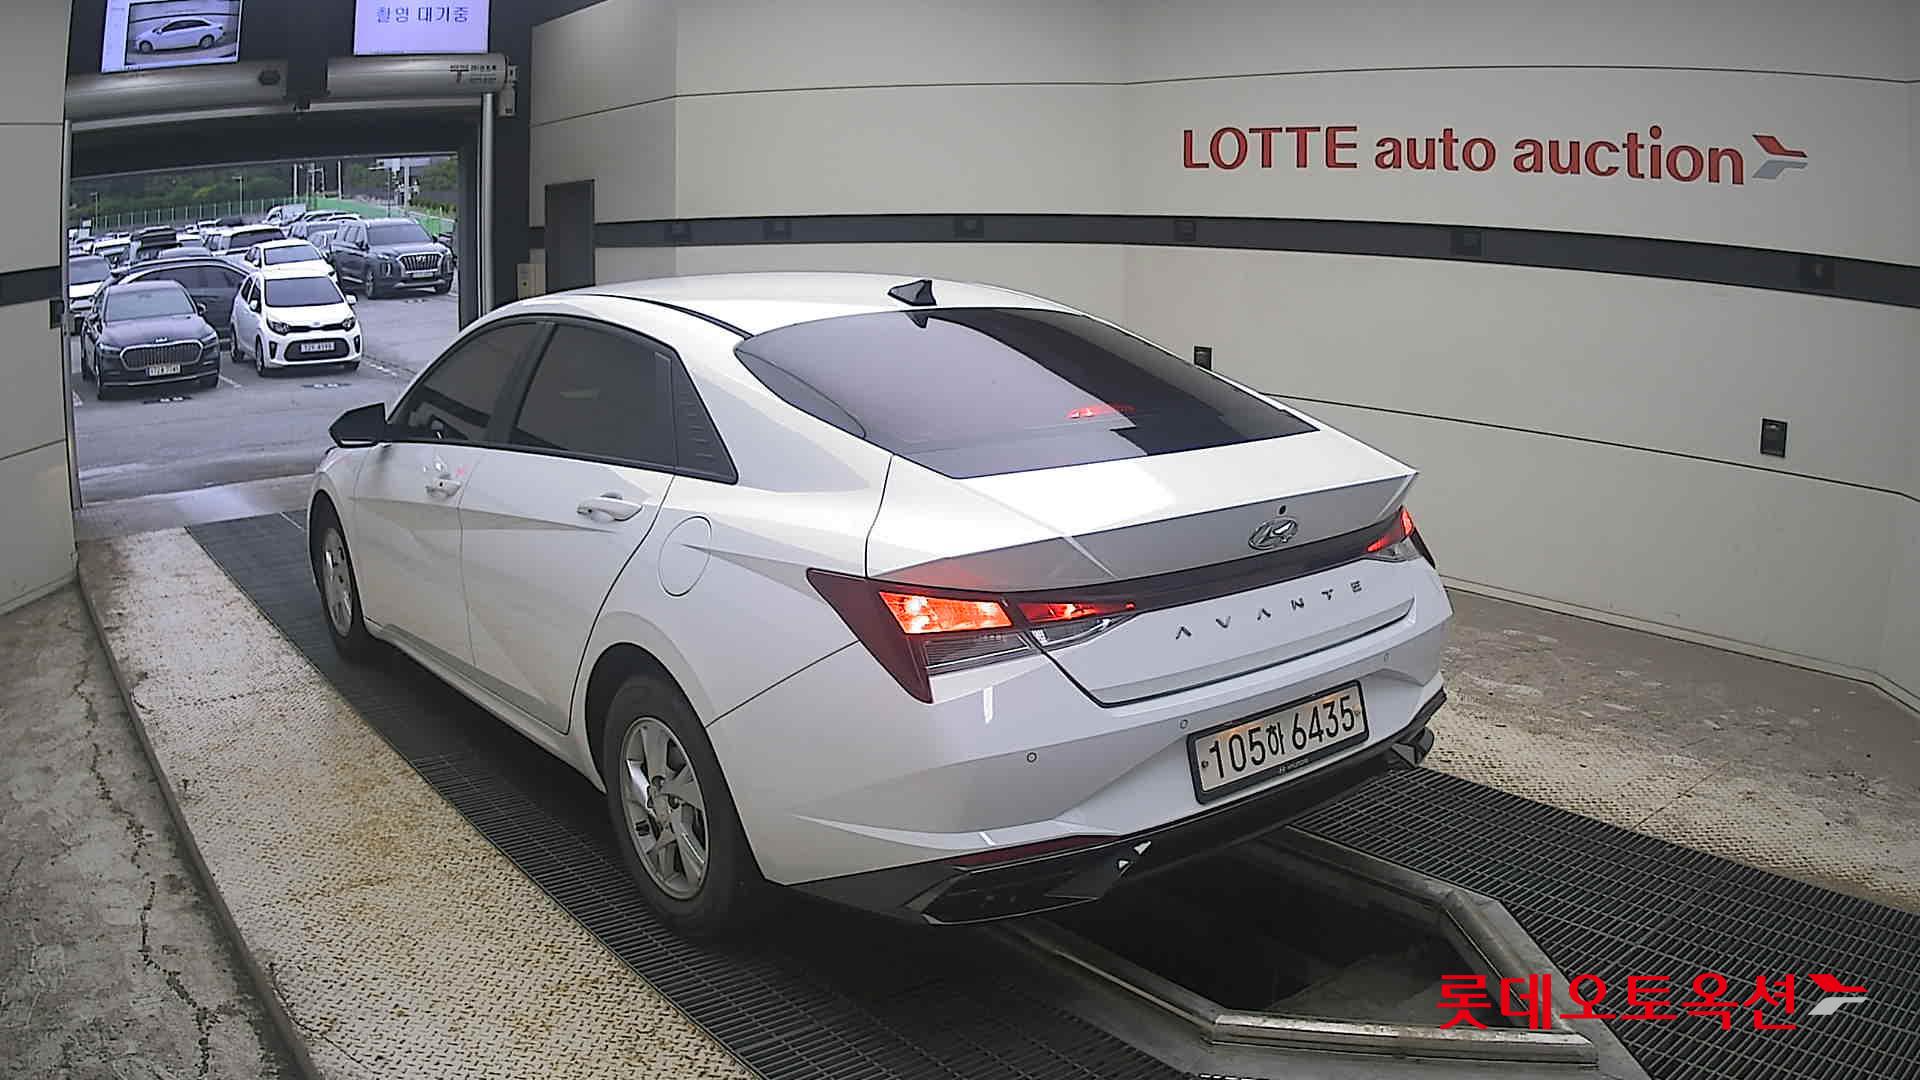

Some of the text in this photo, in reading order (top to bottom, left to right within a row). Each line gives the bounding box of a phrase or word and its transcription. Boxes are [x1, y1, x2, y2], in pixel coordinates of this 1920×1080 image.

[418, 6, 469, 24] 대기중
[1182, 125, 1745, 185] LOTTE auto auction
[1175, 580, 1362, 640] AVANTE
[1208, 694, 1356, 779] 105하 6435
